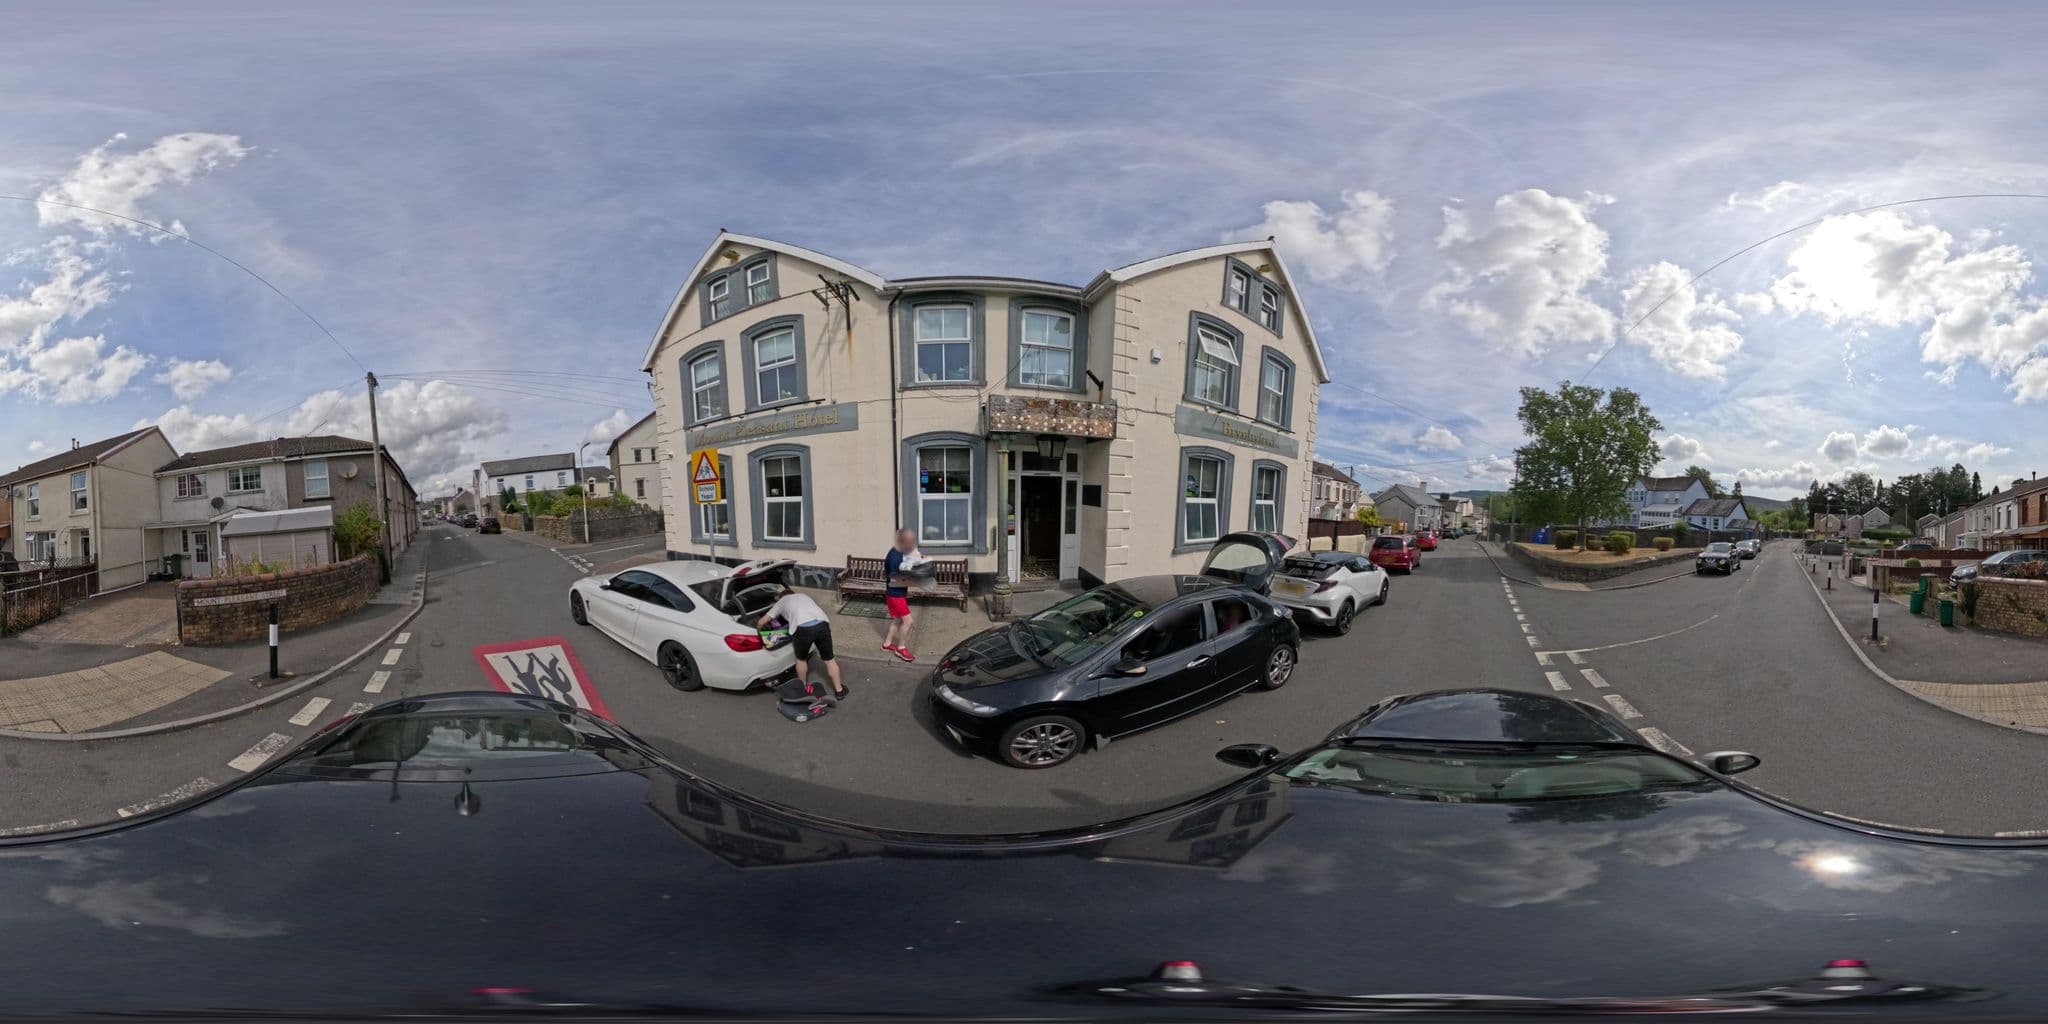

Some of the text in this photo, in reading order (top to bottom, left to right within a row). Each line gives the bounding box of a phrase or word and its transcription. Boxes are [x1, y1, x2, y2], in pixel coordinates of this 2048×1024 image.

[792, 408, 840, 429] Hotel
[196, 597, 220, 606] MOUNT
[224, 592, 258, 604] PLEASANT
